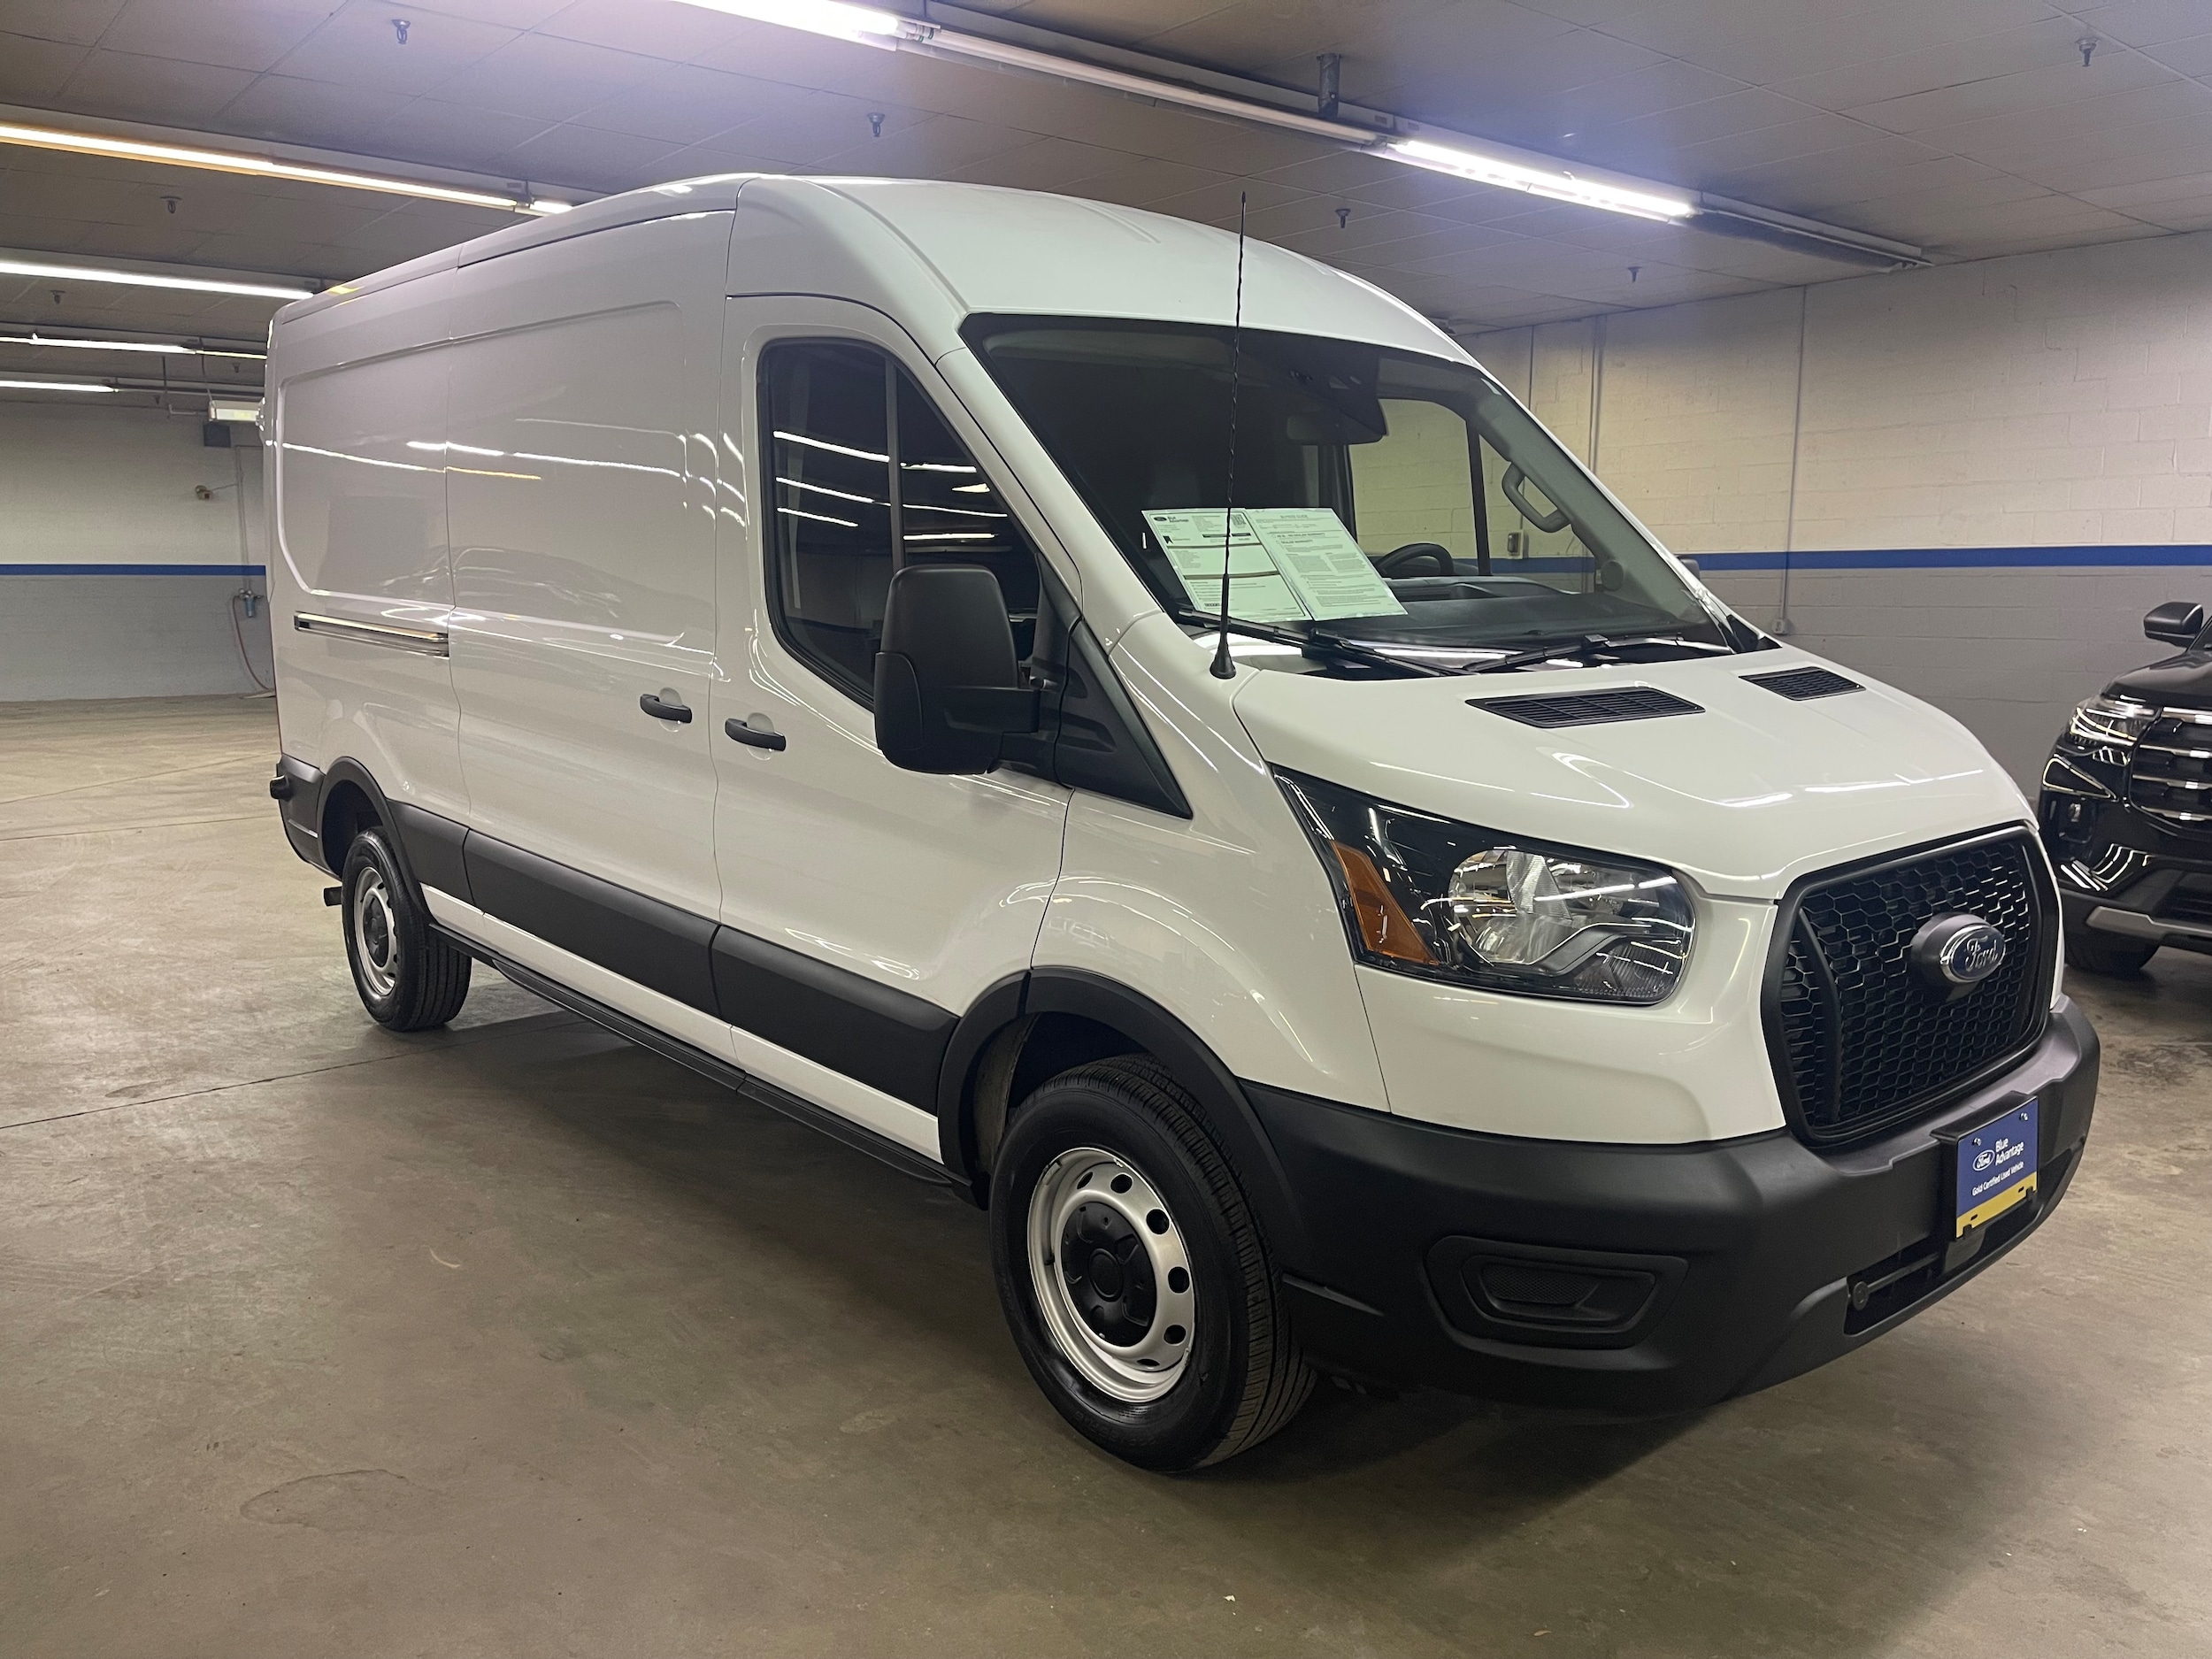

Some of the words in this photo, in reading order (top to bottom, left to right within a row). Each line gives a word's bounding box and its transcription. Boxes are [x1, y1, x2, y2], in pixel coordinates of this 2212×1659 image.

[1965, 935, 1998, 972] Ford
[1995, 1138, 2008, 1153] Blue
[1995, 1141, 2024, 1165] Advantage
[1976, 1153, 1991, 1168] Ford
[1972, 1183, 1983, 1195] Gold
[1983, 1173, 2001, 1190] Certified
[2001, 1168, 2010, 1180] Used
[2010, 1161, 2024, 1174] Vehicle
